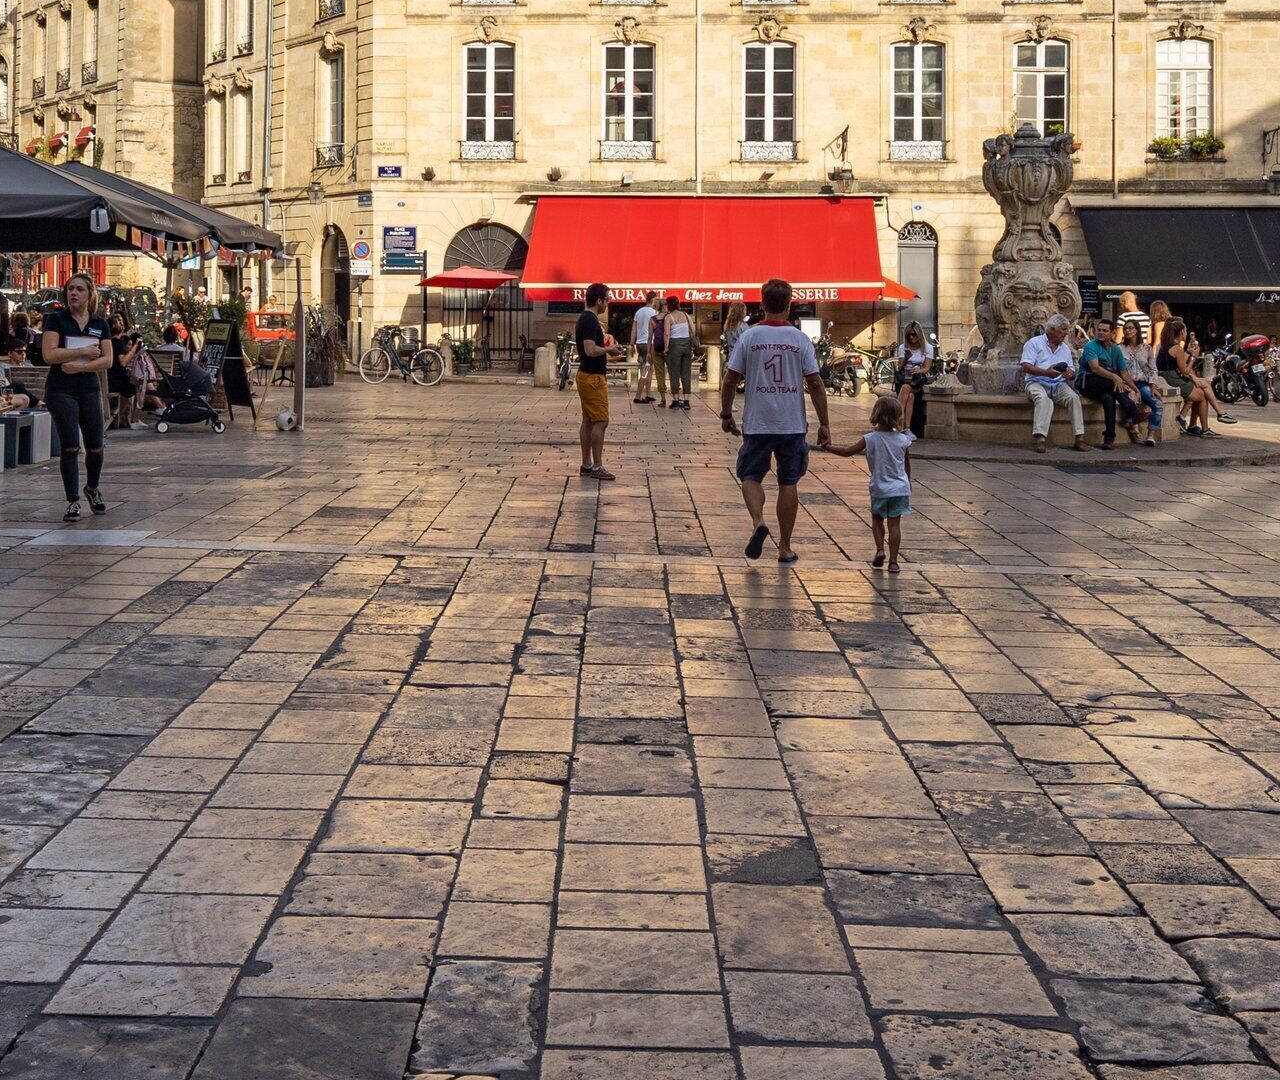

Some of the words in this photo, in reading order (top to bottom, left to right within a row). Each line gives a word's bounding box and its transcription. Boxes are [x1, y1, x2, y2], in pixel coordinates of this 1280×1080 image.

[684, 289, 712, 301] Chez
[716, 289, 744, 301] Jean
[791, 289, 840, 300] SSERIE
[751, 343, 800, 354] SAINT-TROPEZ
[764, 354, 782, 383] 1
[756, 386, 776, 394] POLO
[777, 386, 798, 394] TEAM
